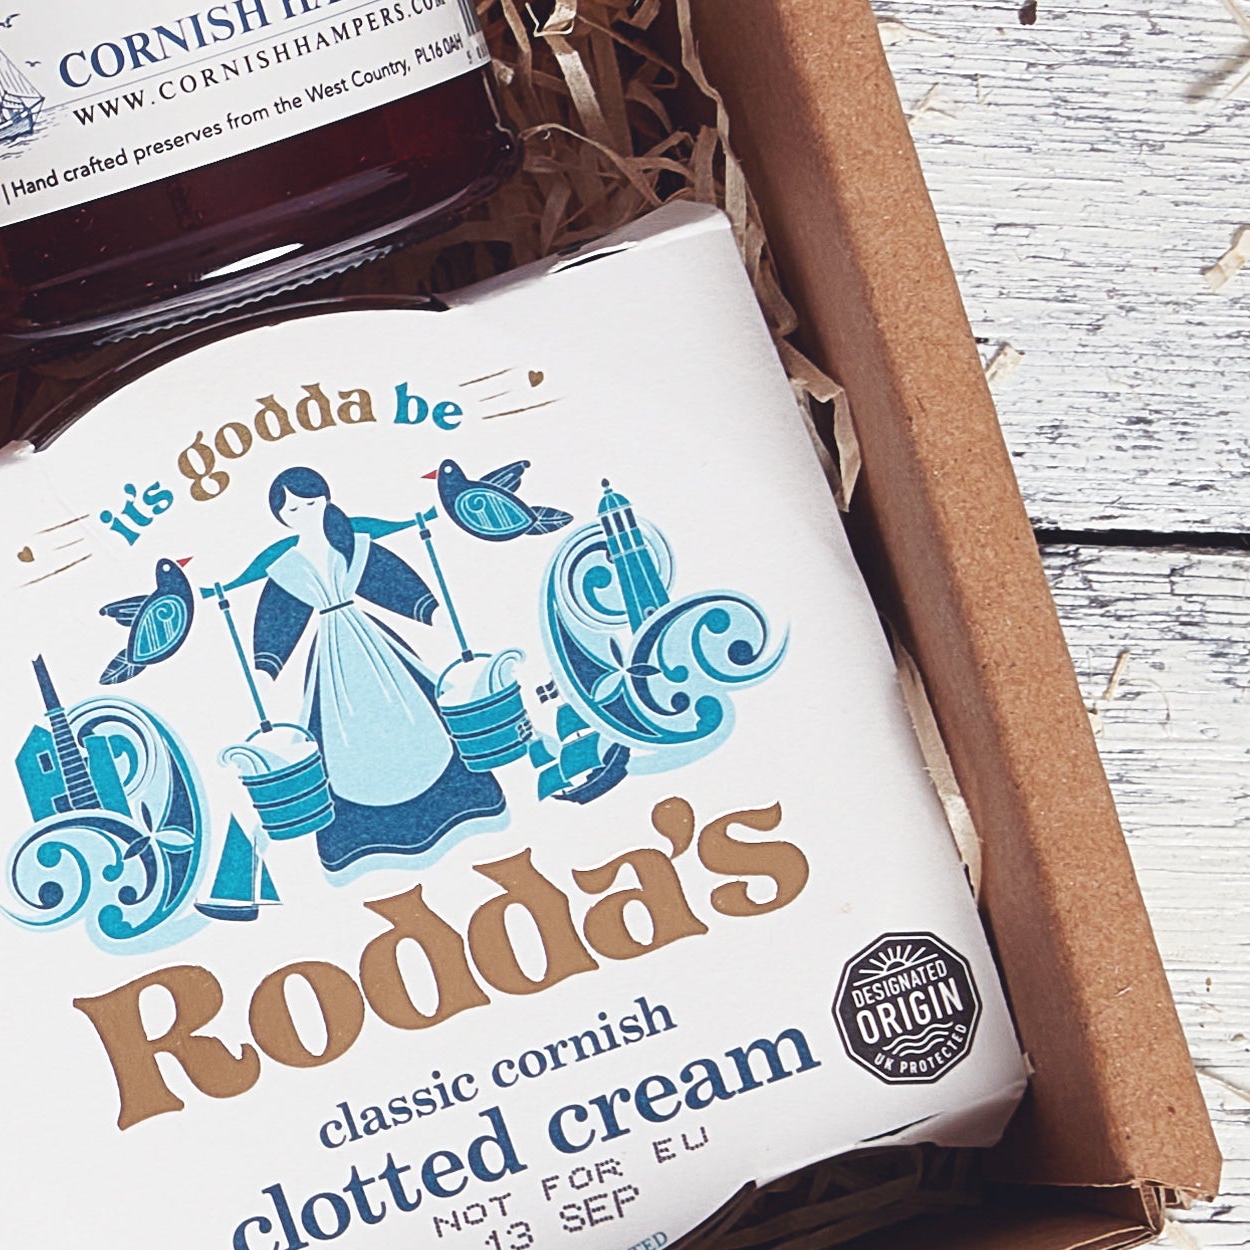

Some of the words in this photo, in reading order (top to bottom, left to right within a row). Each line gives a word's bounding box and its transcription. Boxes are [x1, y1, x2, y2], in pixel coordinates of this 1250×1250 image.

[59, 0, 272, 88] CORNISH
[11, 169, 59, 198] Hand
[63, 148, 129, 183] crafted
[133, 122, 223, 165] preserves
[226, 106, 269, 130] from
[273, 95, 303, 115] the
[305, 79, 350, 103] West
[351, 58, 412, 88] Country,
[176, 381, 377, 503] godda
[393, 381, 463, 430] be
[851, 959, 948, 1008] DESIGNATED
[856, 978, 964, 1045] ORIGIN
[319, 1071, 480, 1153] classic
[490, 997, 678, 1087] cornish
[547, 1028, 822, 1157] cream
[874, 1053, 894, 1071] UK
[900, 1024, 968, 1074] PROTECTED
[433, 1193, 512, 1238] NOT
[541, 1158, 624, 1201] FOR
[652, 1127, 709, 1163] EU
[559, 1184, 640, 1233] SEP
